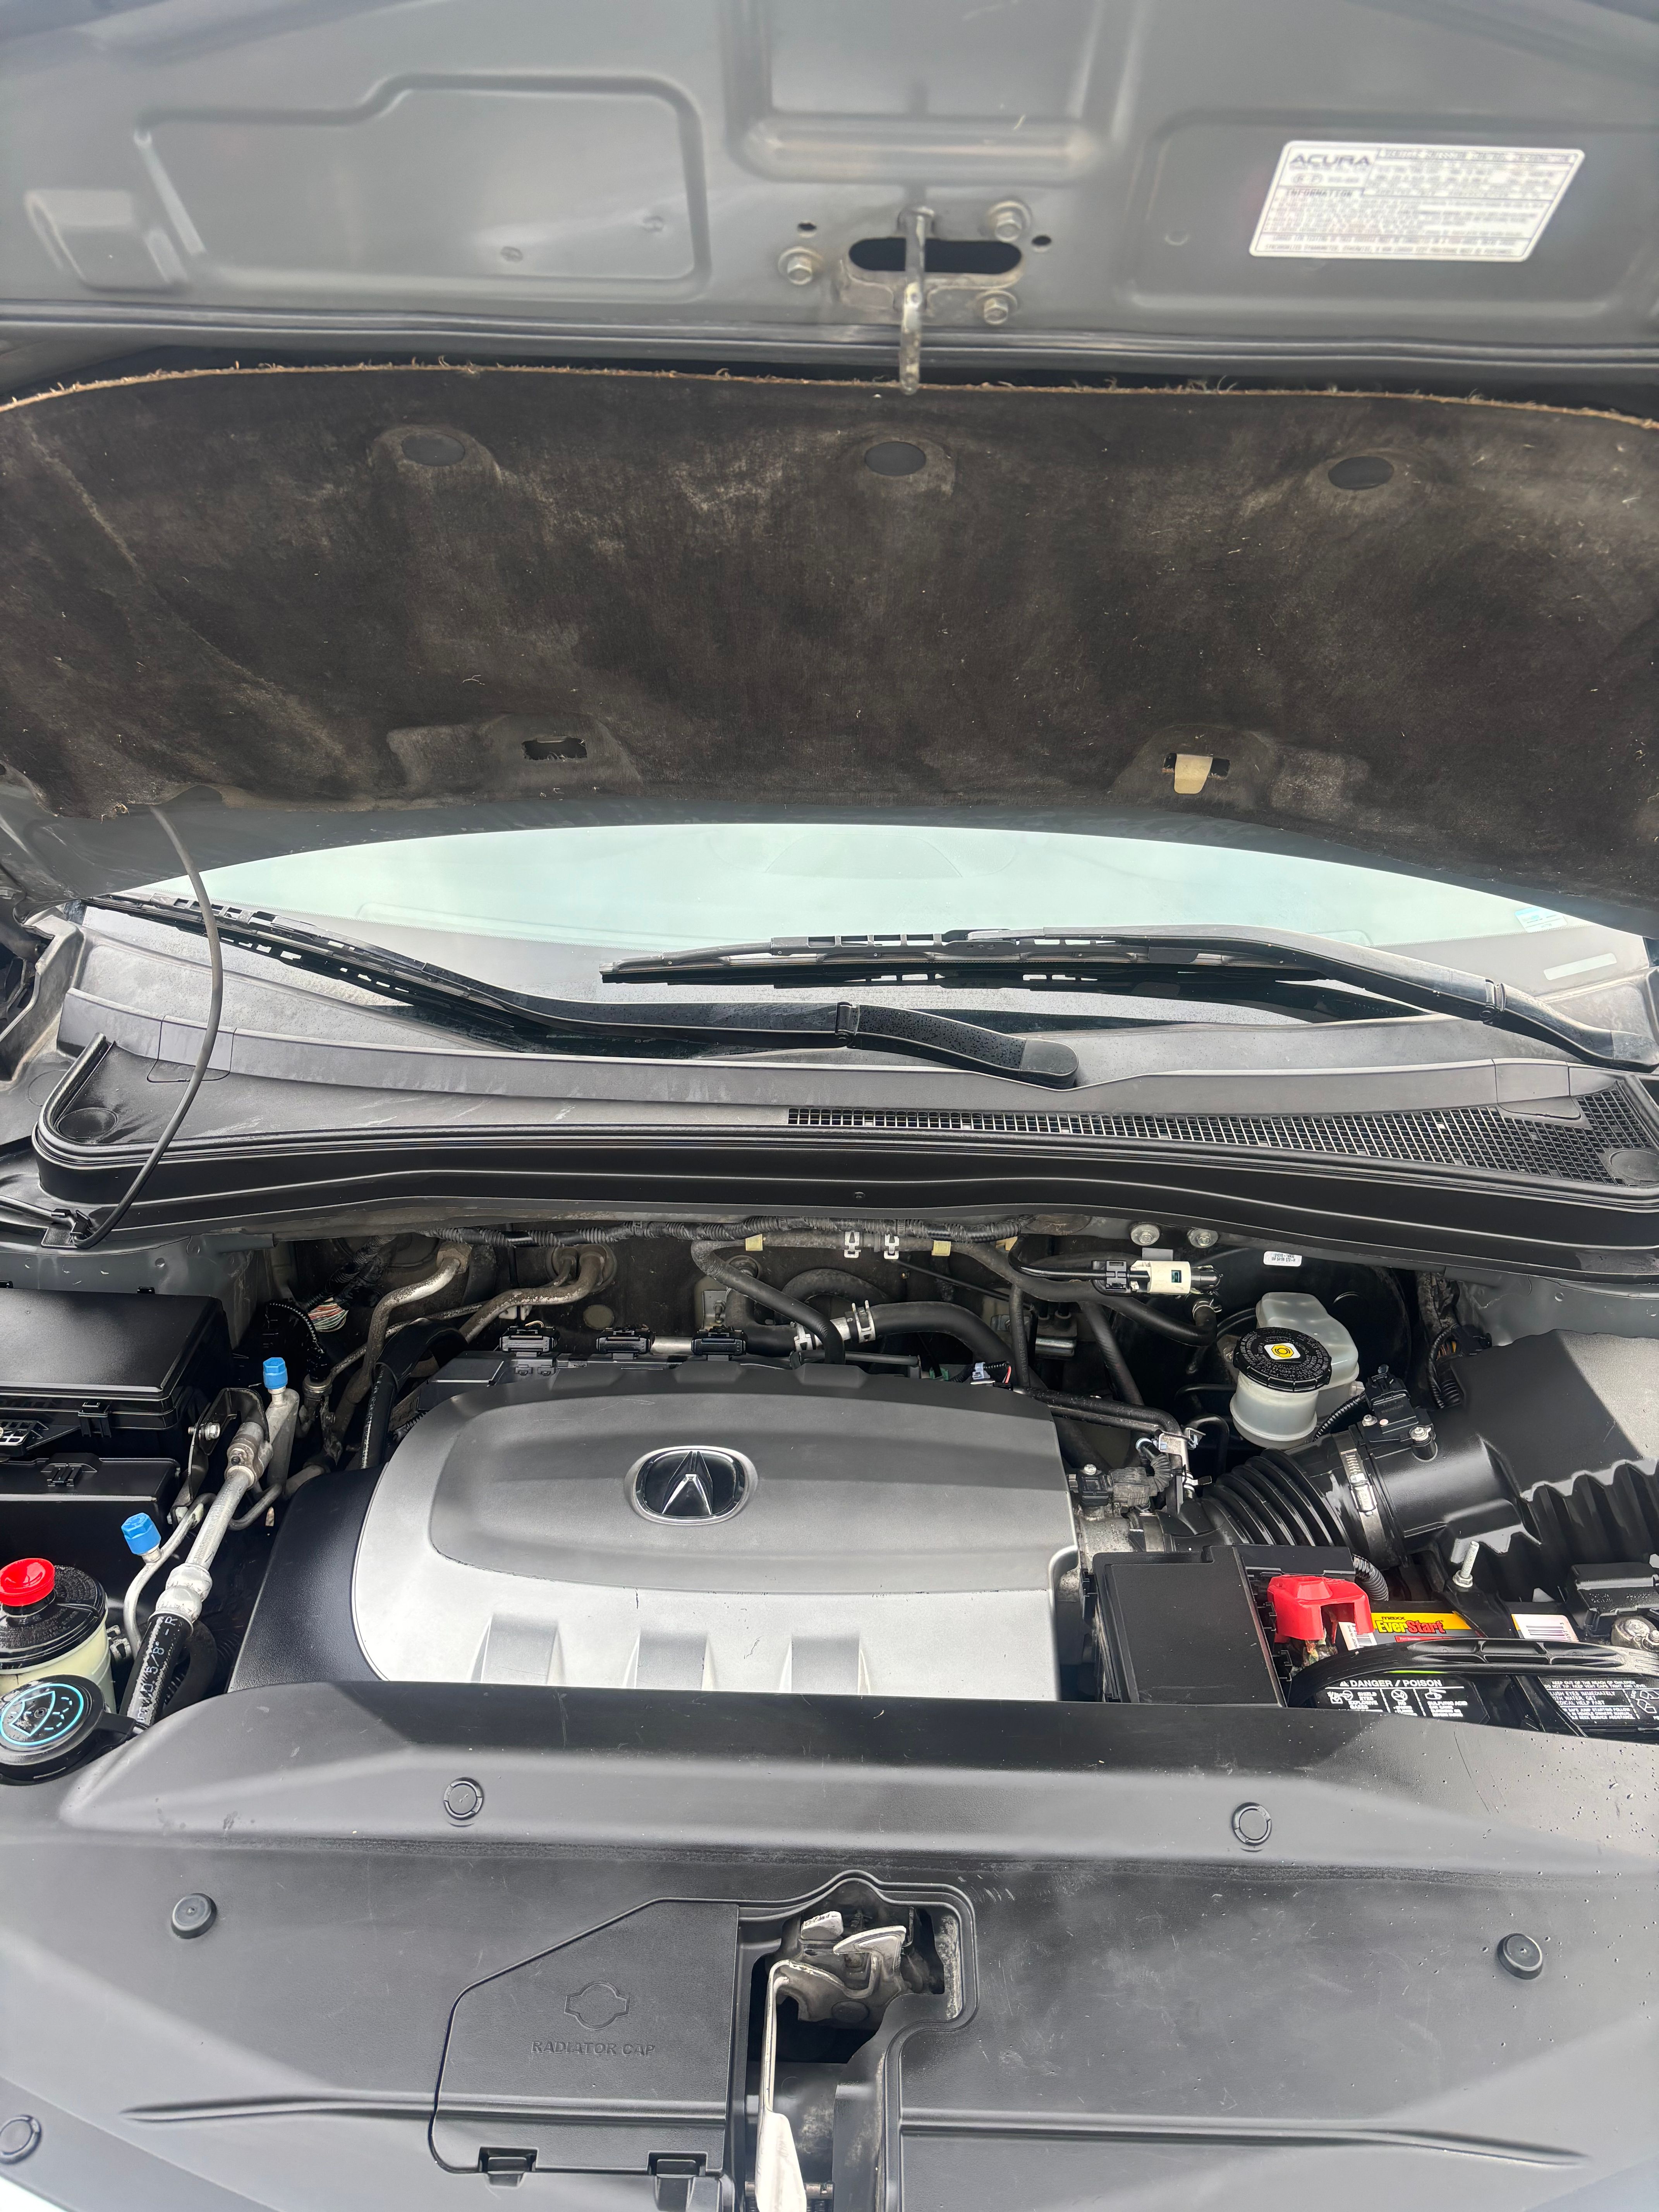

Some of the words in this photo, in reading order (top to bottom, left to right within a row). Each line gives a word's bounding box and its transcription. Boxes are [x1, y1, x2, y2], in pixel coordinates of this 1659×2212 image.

[1290, 154, 1370, 165] ACURA
[1375, 1620, 1446, 1634] EverStart
[531, 2041, 617, 2055] RADIATOR
[622, 2044, 655, 2056] CAP
